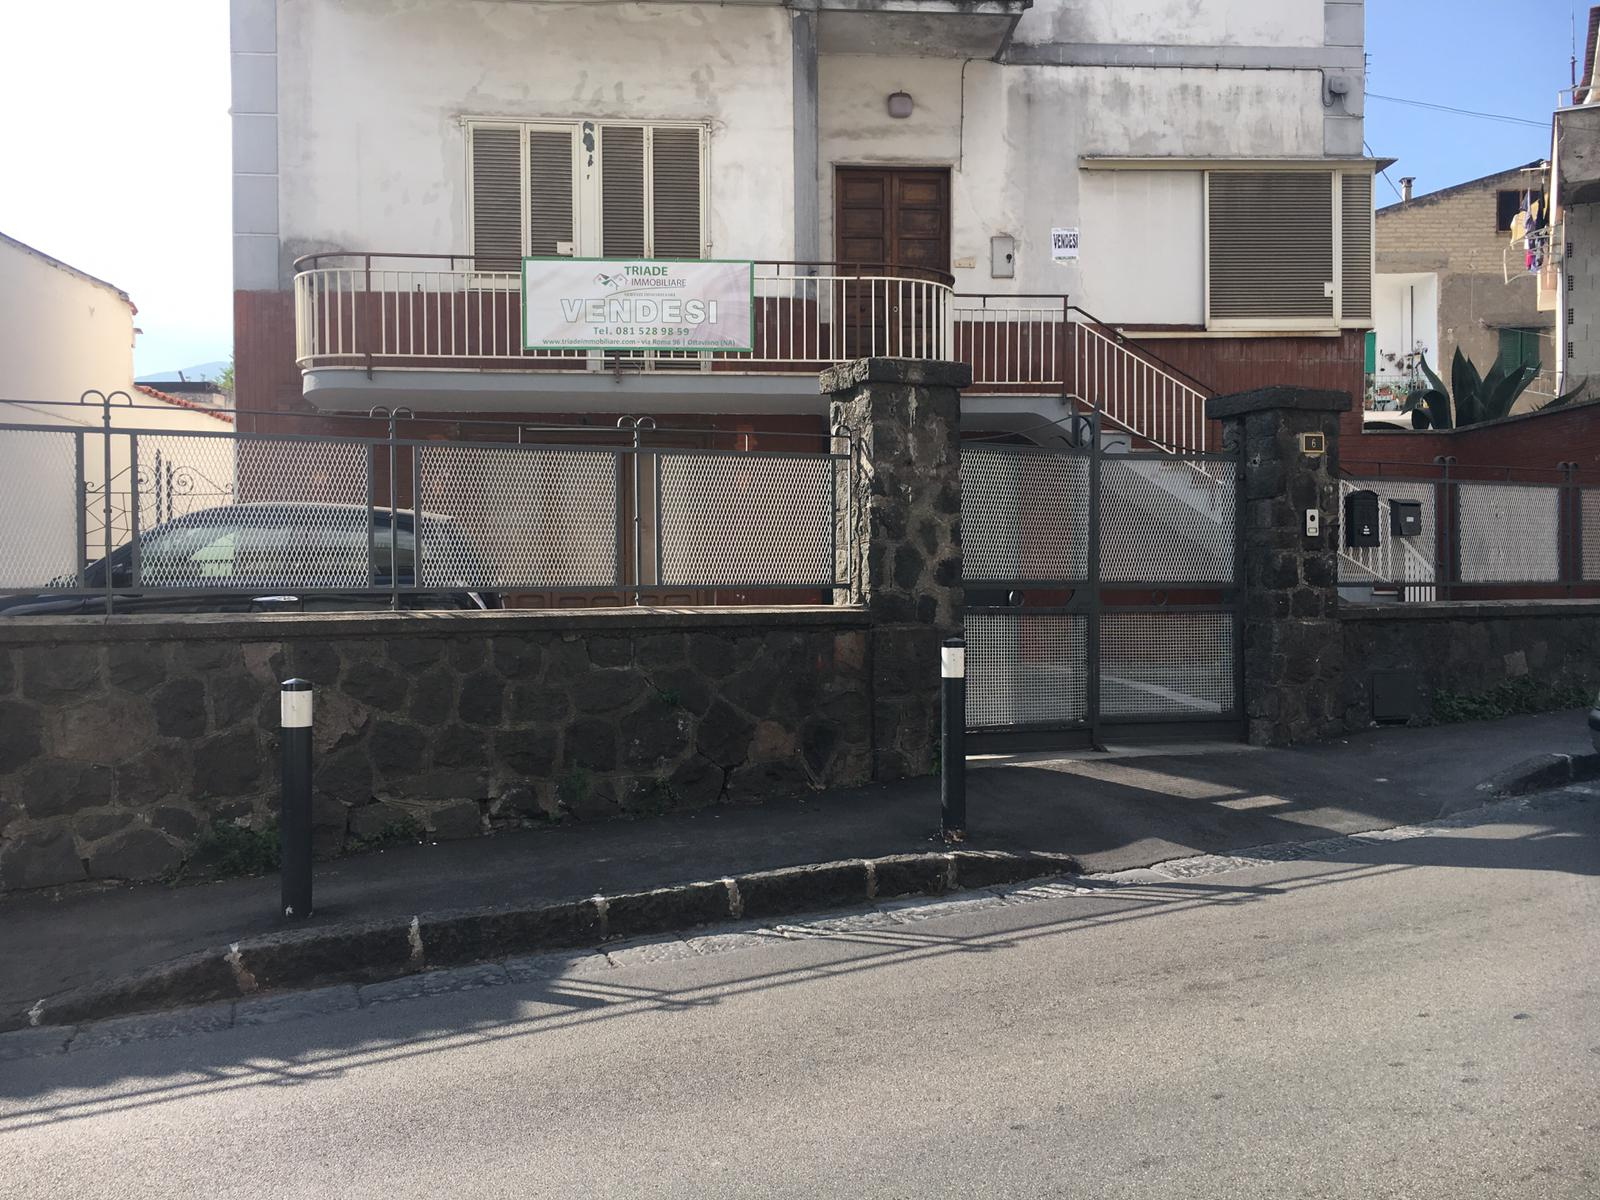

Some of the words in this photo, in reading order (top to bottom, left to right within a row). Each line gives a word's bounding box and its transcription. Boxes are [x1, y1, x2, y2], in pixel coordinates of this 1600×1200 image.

[1053, 234, 1078, 248] VENDESI
[624, 266, 669, 276] TRIADE
[631, 278, 687, 287] IMMOBILIARE
[560, 298, 718, 324] VENDESI
[593, 327, 613, 335] Tel.
[616, 327, 634, 335] 081
[639, 327, 658, 335] 528
[661, 327, 674, 336] 98
[677, 327, 690, 336] 59
